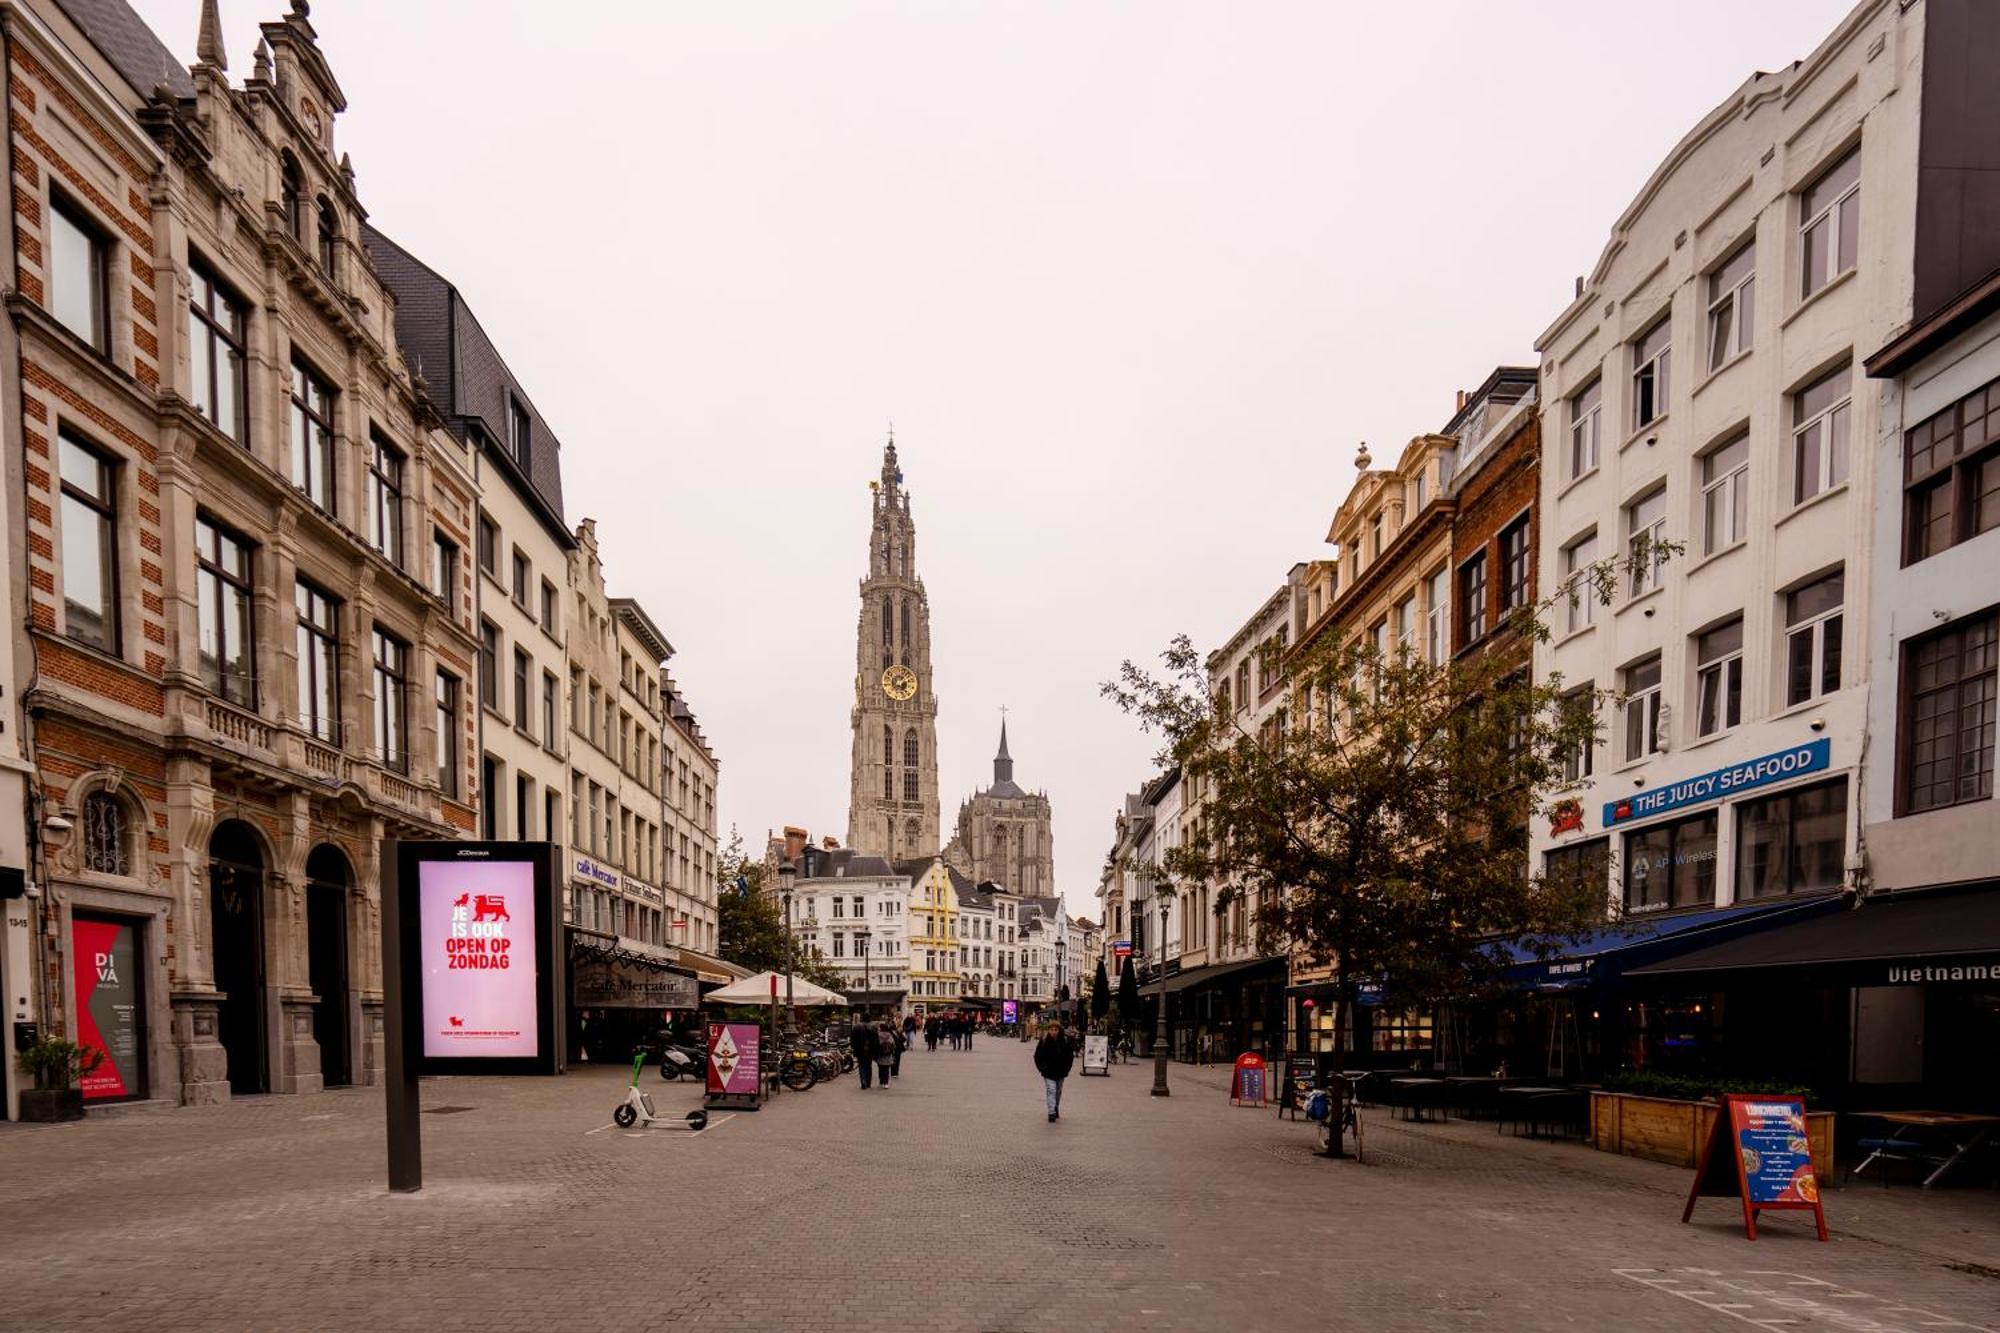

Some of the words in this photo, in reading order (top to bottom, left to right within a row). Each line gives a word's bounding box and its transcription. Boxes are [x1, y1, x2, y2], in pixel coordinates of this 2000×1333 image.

[1636, 792, 1666, 811] THE
[1668, 776, 1717, 803] JUICY
[1720, 750, 1813, 789] SEAFOOD
[452, 907, 468, 921] JE
[452, 922, 467, 937] IS
[472, 922, 503, 937] OOK
[446, 938, 485, 953] OPEN
[490, 938, 511, 953] OP
[448, 954, 509, 969] ZONDAG
